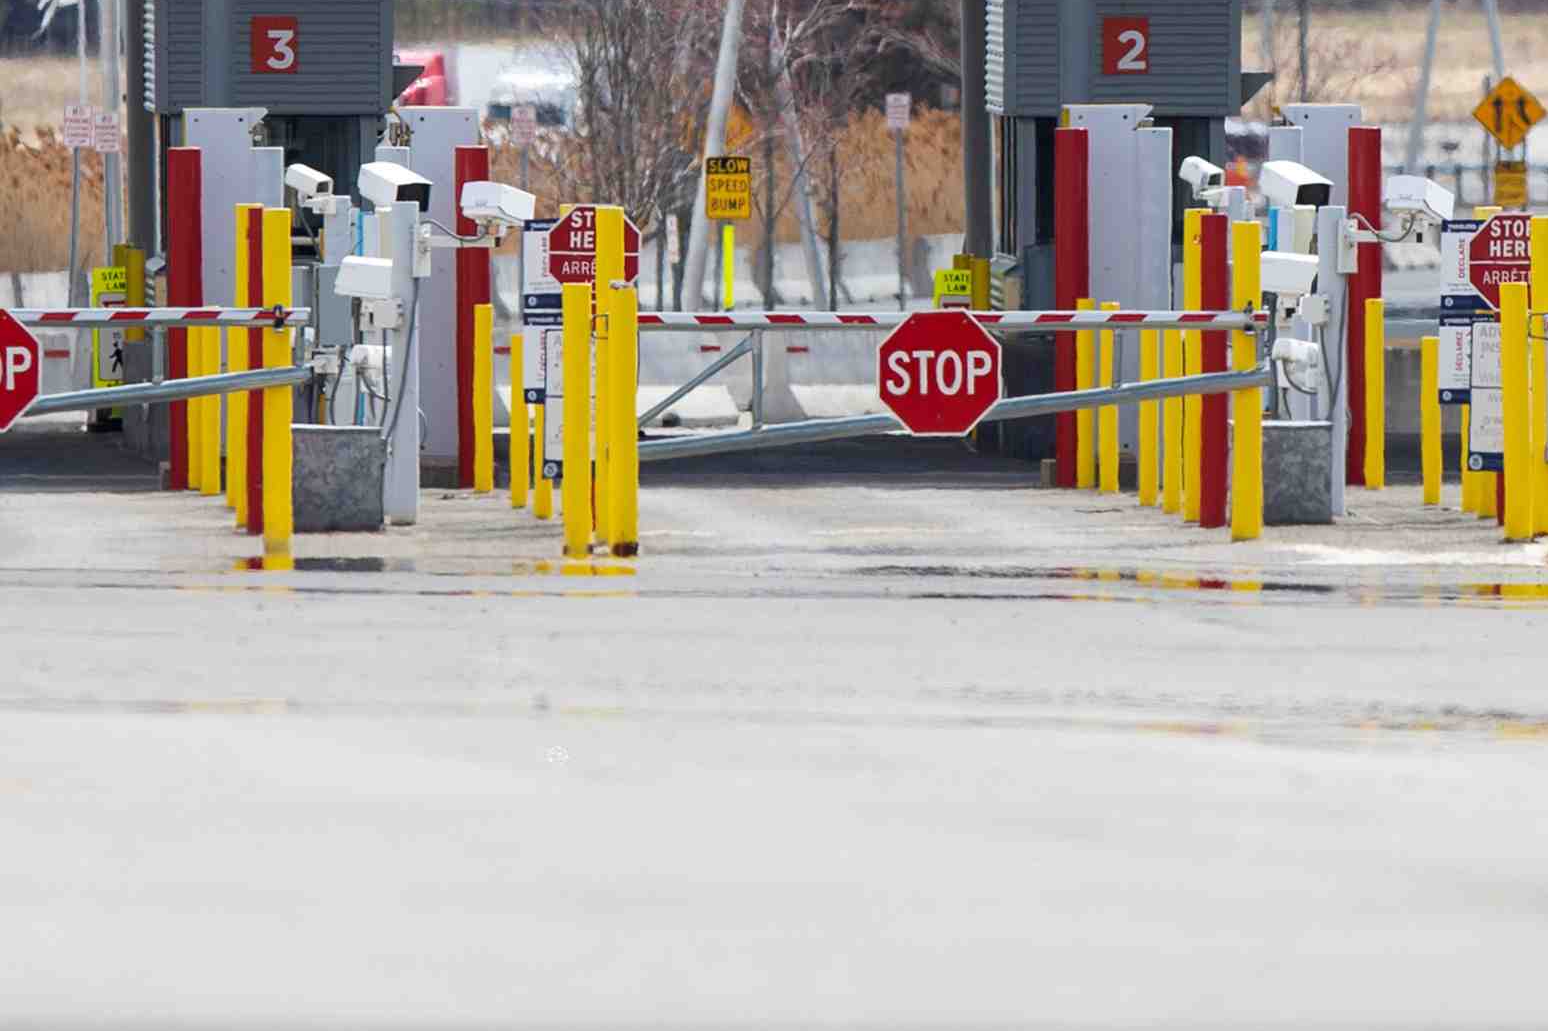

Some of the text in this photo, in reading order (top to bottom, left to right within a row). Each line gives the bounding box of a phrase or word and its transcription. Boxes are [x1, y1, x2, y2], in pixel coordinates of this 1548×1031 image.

[267, 30, 294, 69] 3
[1118, 30, 1146, 69] 2
[710, 160, 748, 171] SLOW
[710, 178, 747, 191] SPEED
[711, 198, 746, 210] BUMP
[571, 211, 595, 228] ST
[570, 231, 595, 248] HE
[886, 350, 992, 395] STOP
